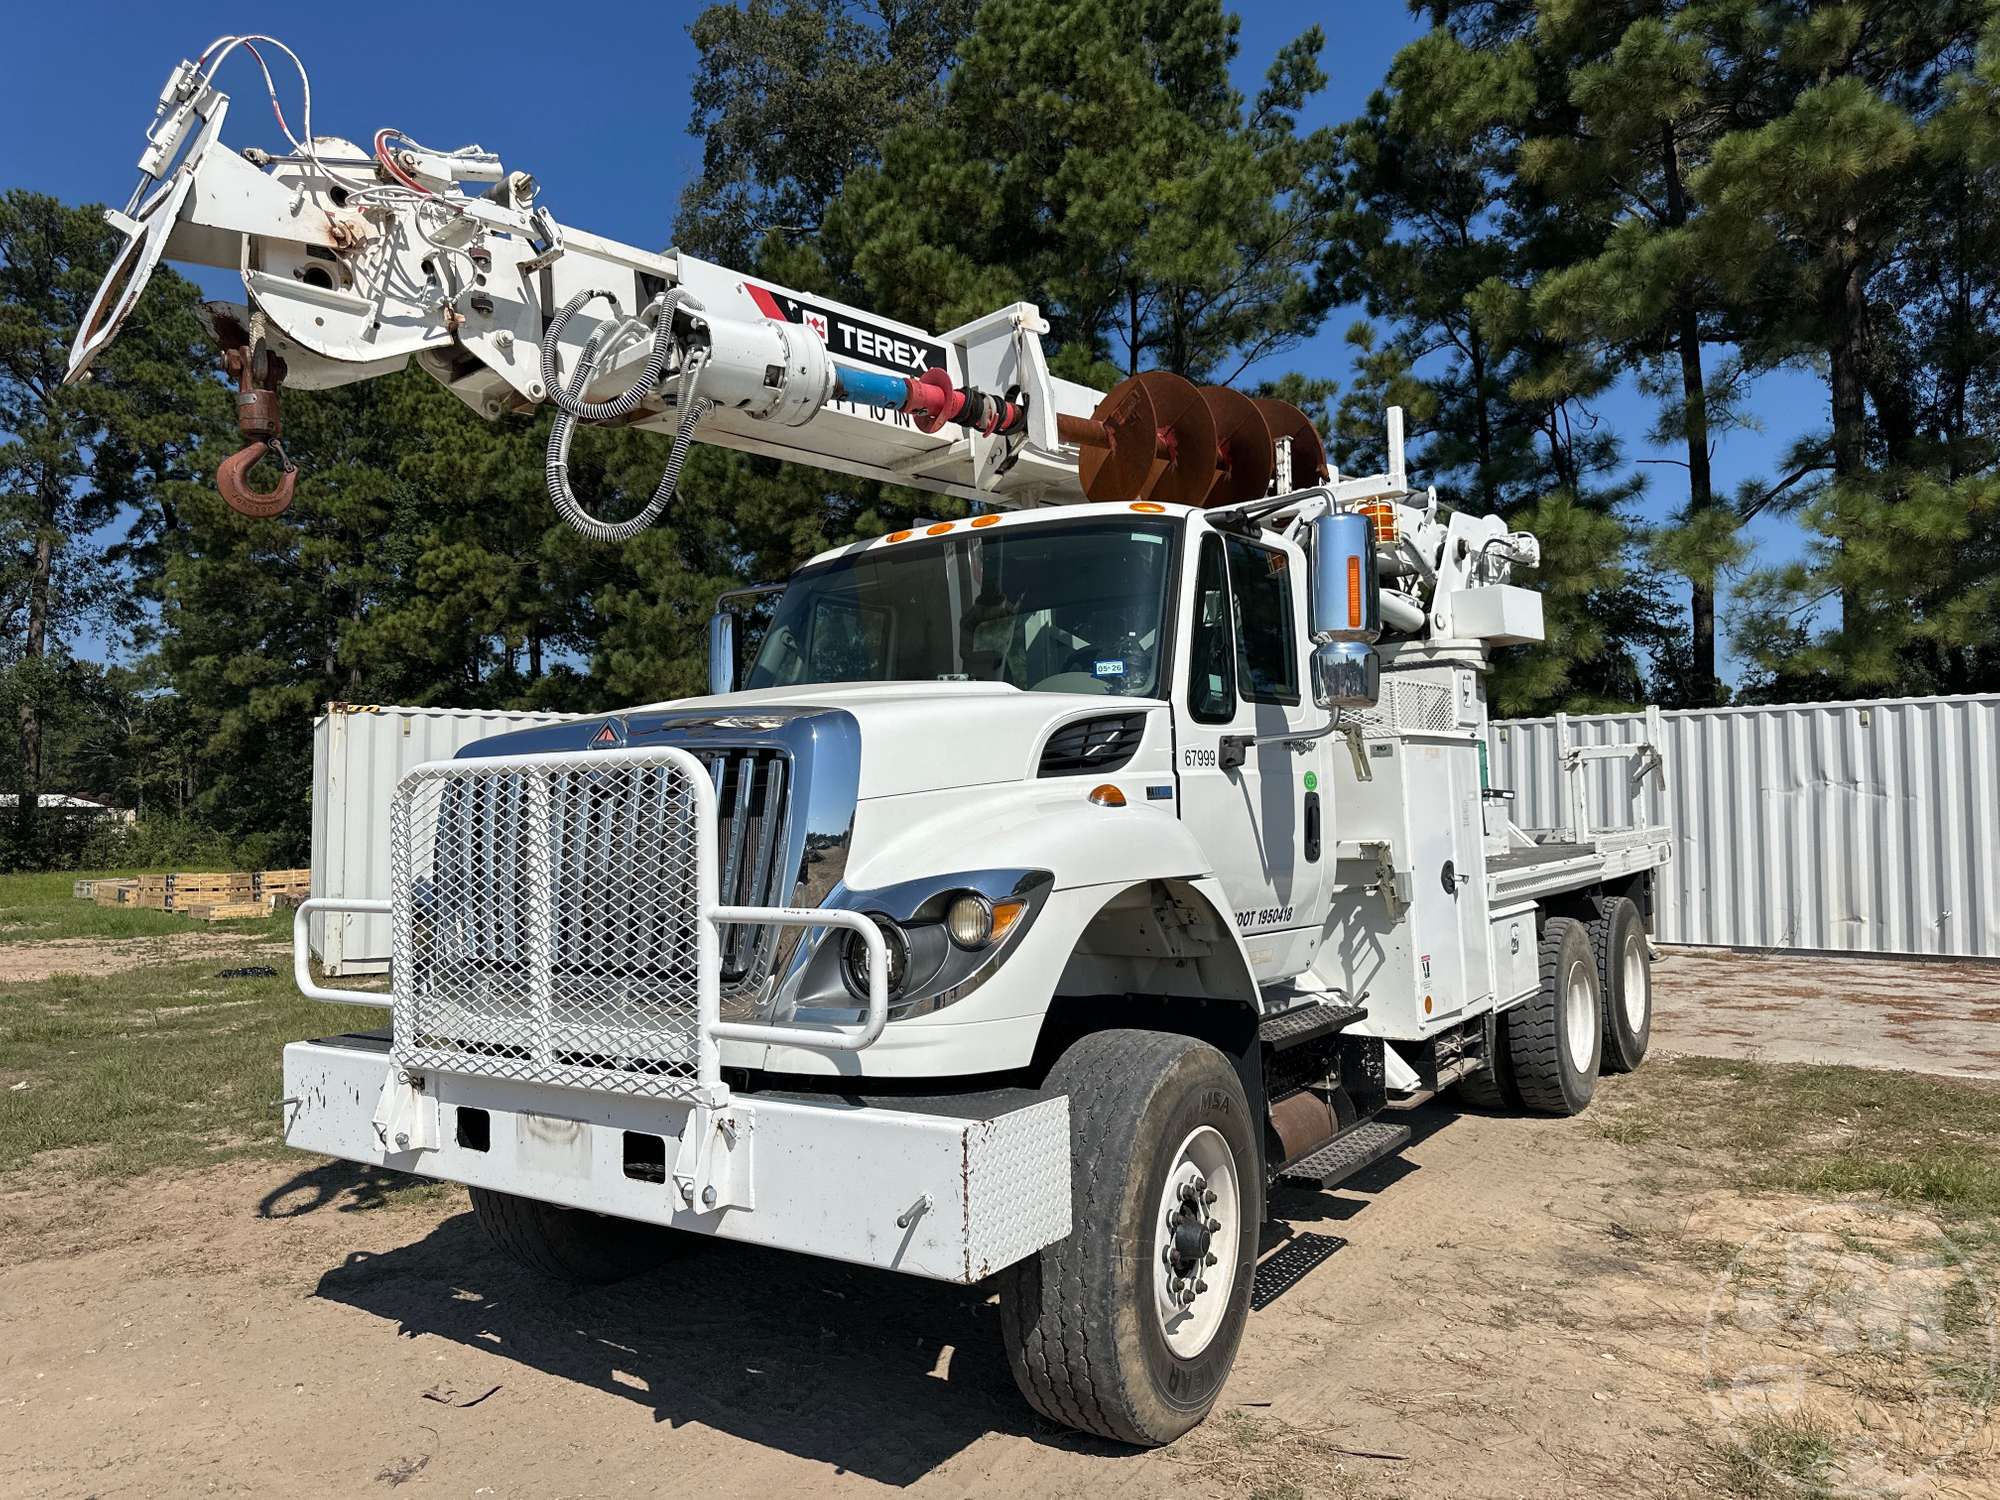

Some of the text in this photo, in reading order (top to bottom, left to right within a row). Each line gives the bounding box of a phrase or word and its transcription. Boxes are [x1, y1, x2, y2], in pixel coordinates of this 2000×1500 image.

[837, 321, 929, 372] TEREX
[1184, 749, 1216, 767] 67999
[1234, 906, 1293, 927] DOT 1950418
